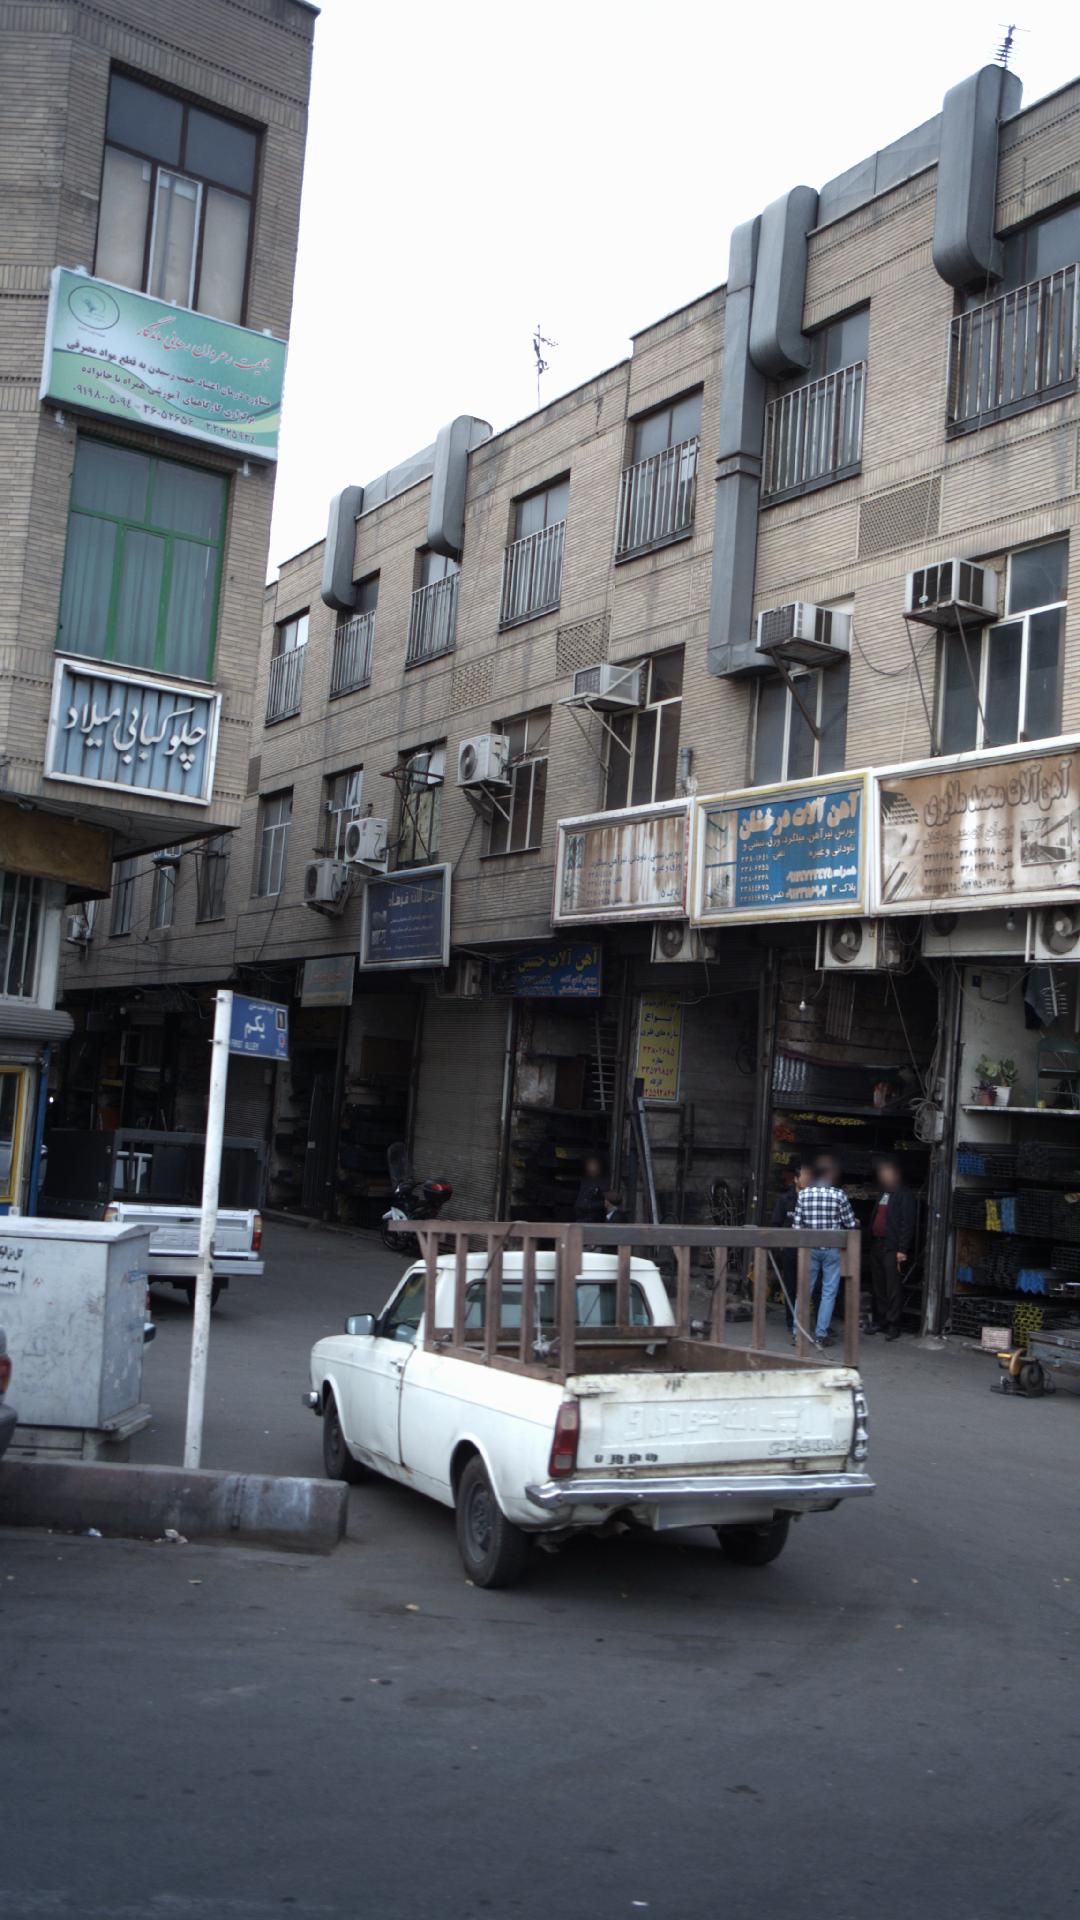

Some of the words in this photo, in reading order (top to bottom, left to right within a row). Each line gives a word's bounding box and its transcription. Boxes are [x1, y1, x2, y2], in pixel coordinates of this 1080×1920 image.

[64, 702, 121, 748] میلاد
[792, 795, 827, 827] آلات
[827, 790, 859, 828] آهن
[243, 1014, 266, 1040] یکم
